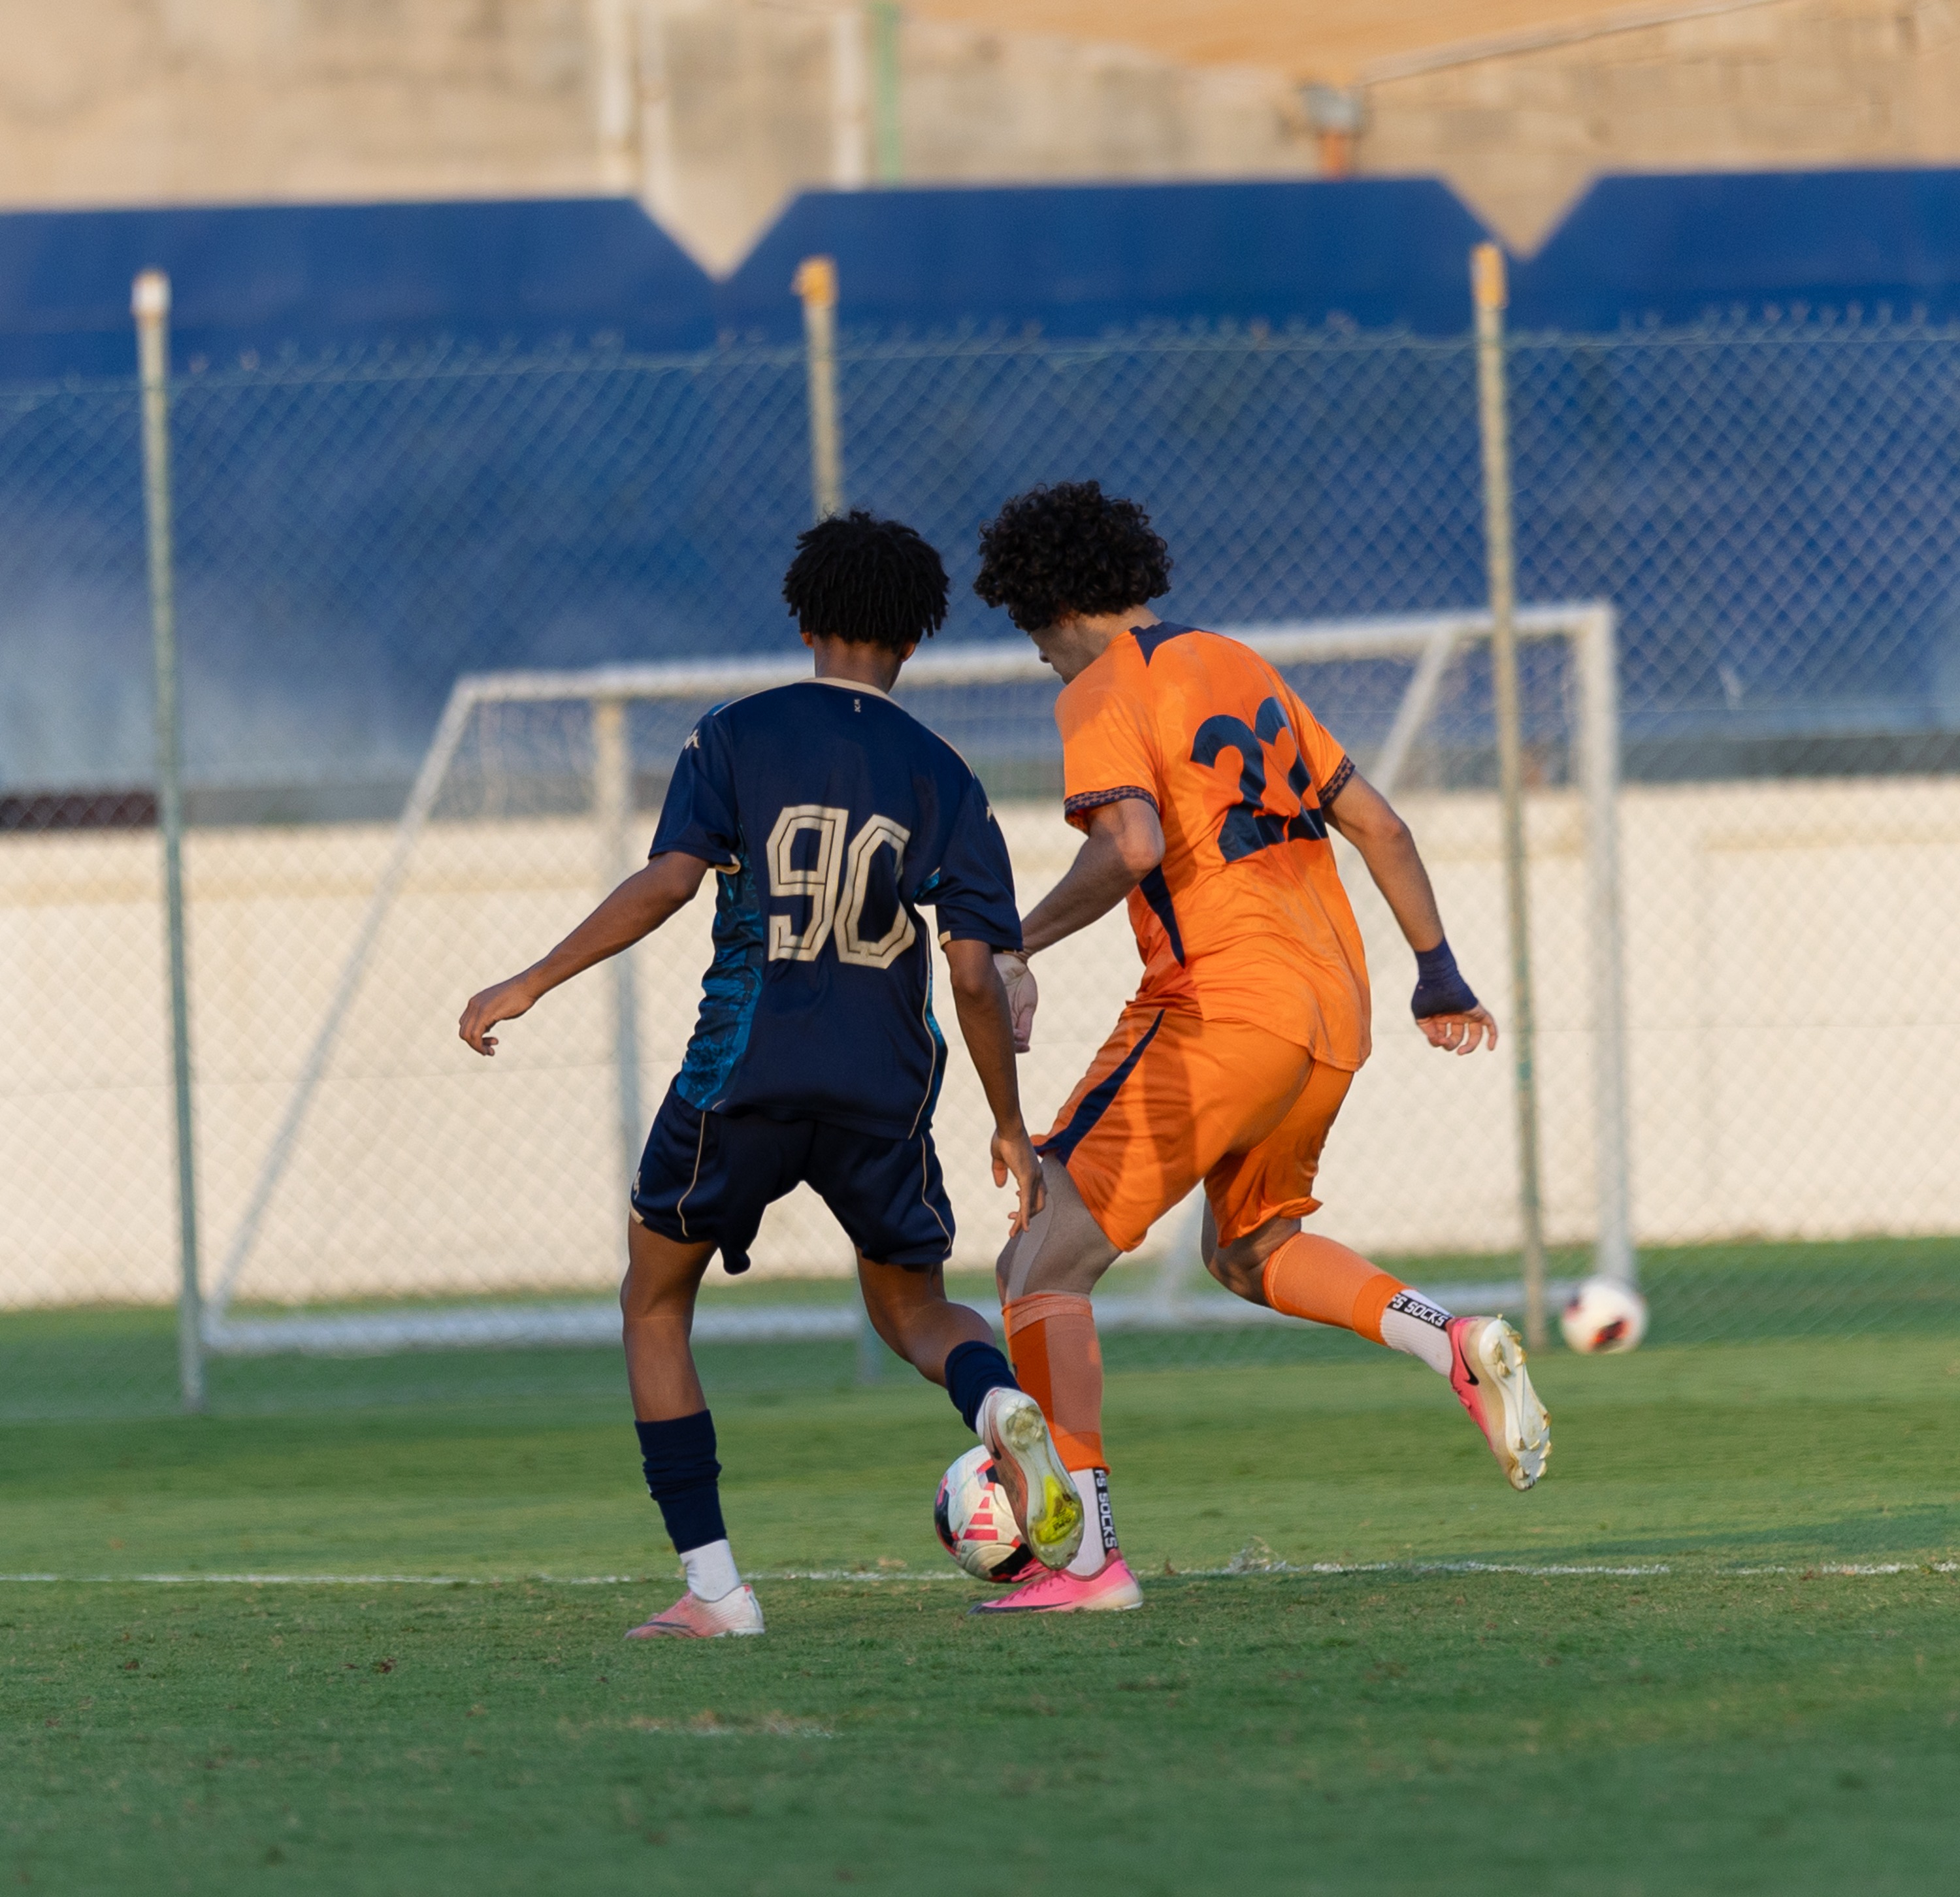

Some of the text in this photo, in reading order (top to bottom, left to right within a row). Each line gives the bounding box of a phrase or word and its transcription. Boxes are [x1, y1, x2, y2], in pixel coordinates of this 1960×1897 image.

[1190, 696, 1328, 864] 22
[766, 805, 915, 969] 90
[1404, 1301, 1448, 1327] SOCKS
[1098, 1493, 1117, 1548] SOCKS
